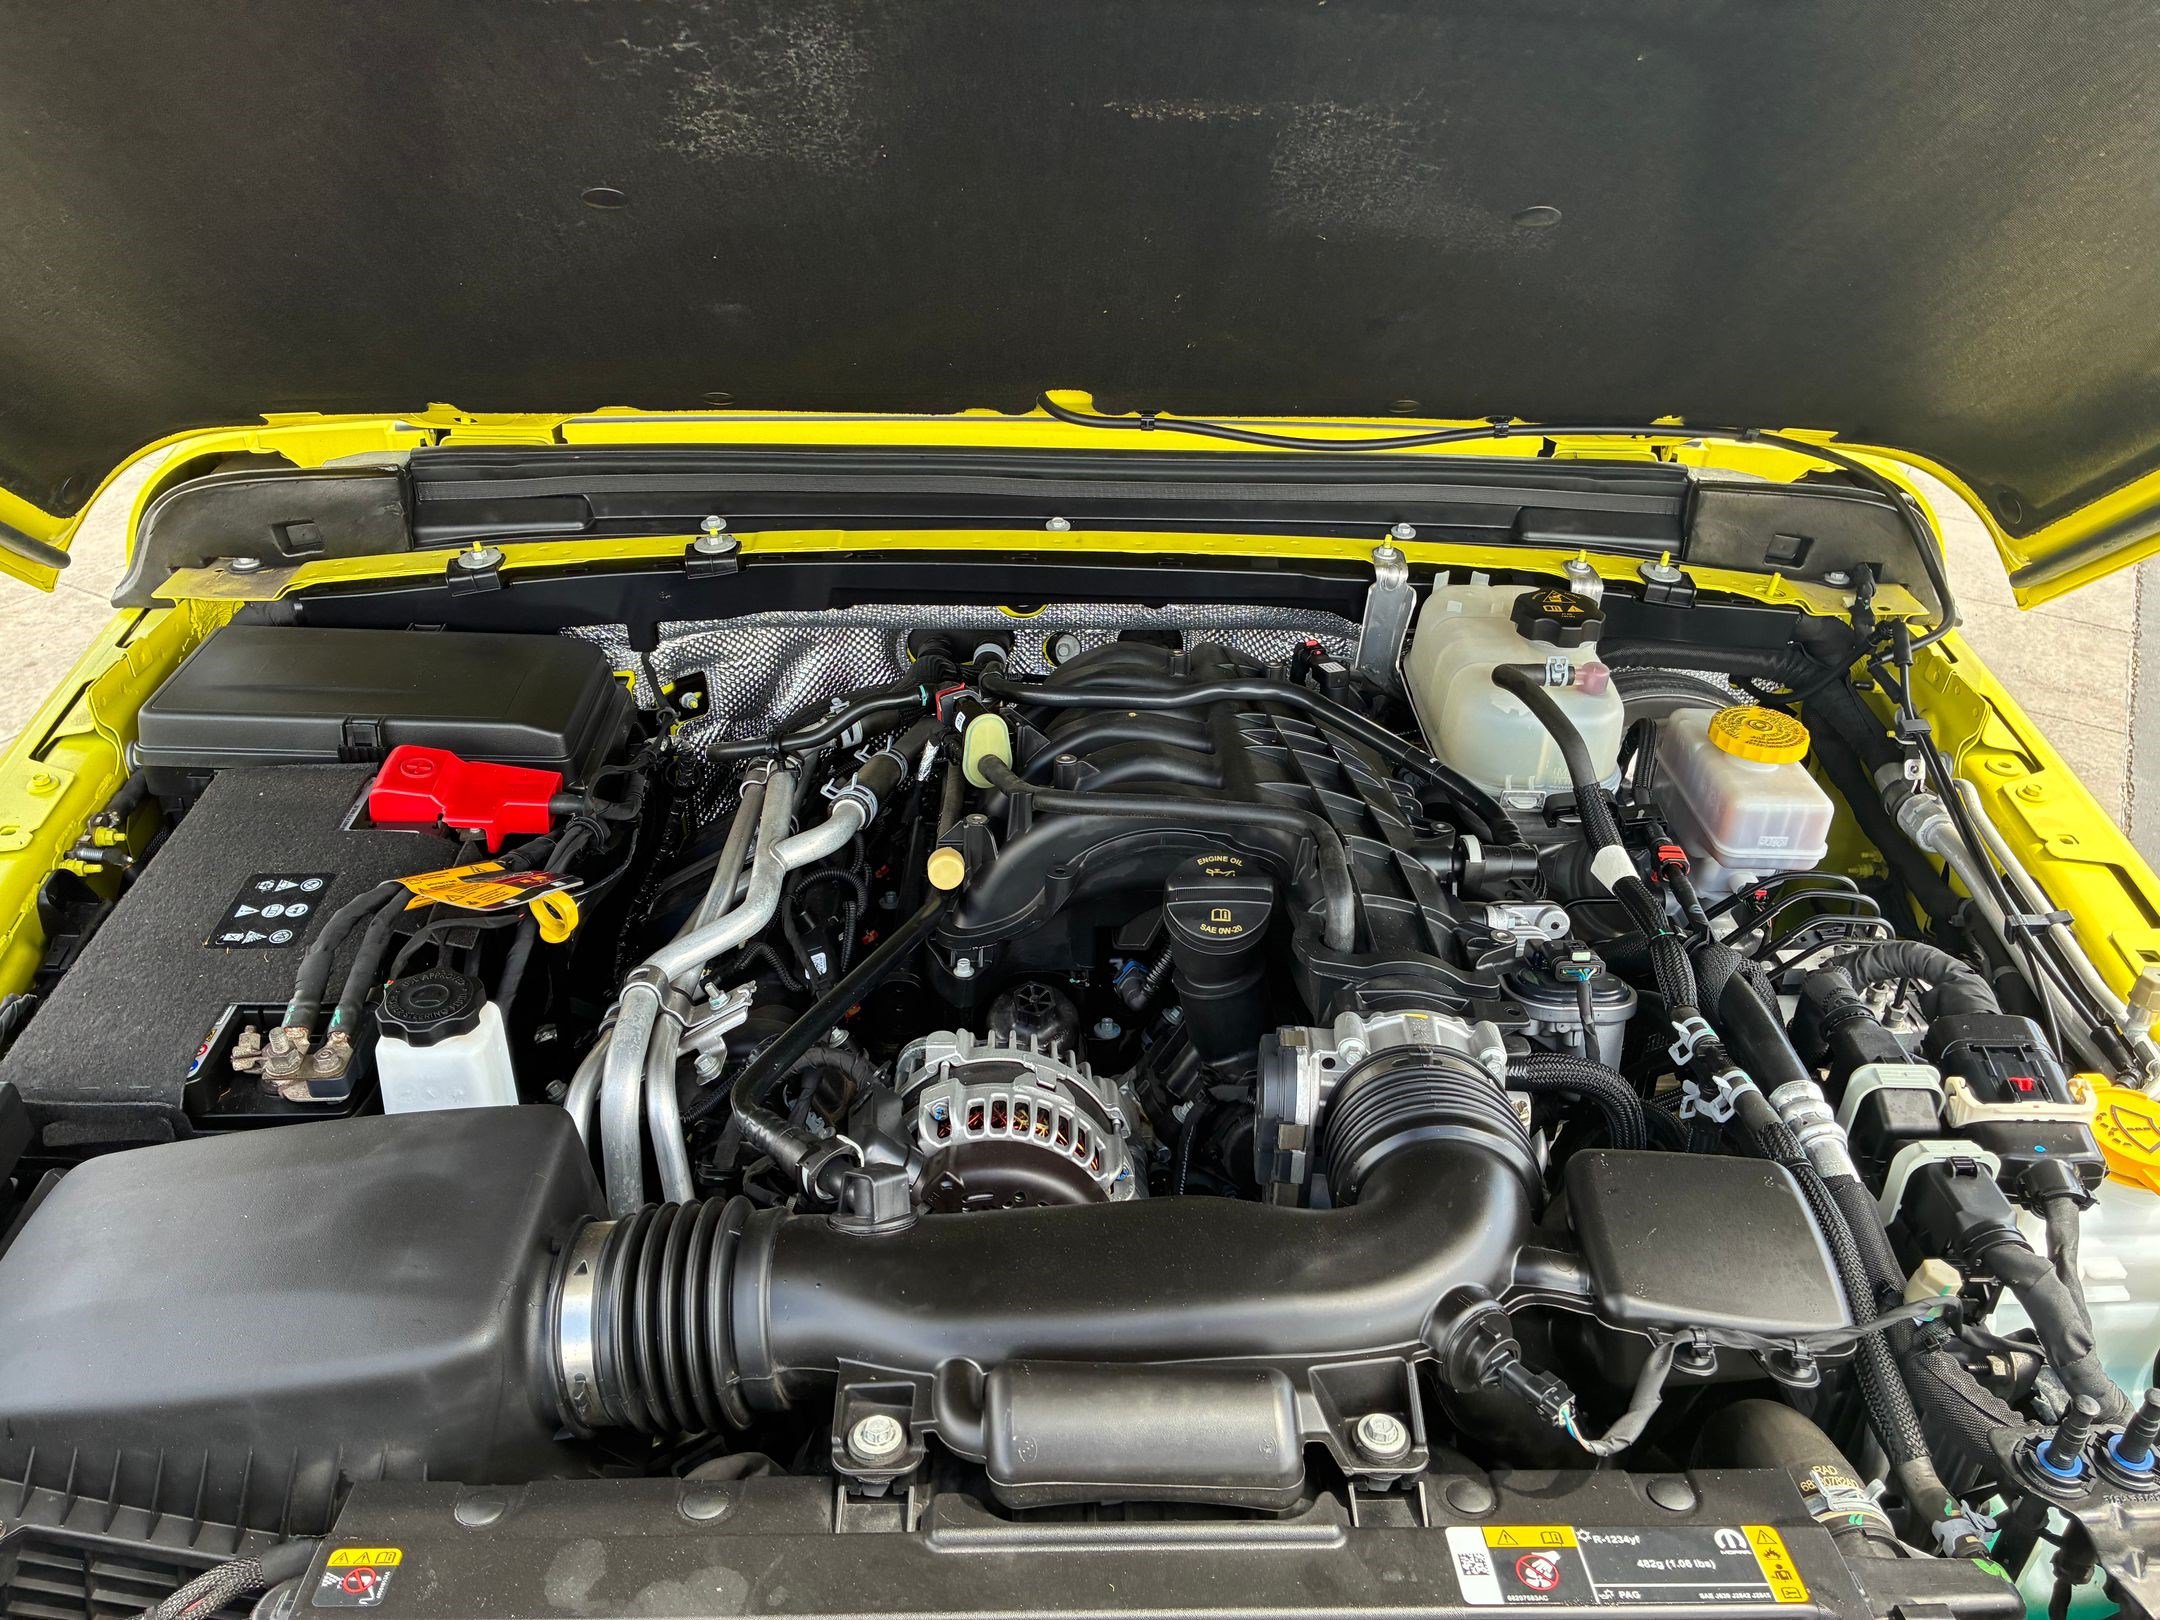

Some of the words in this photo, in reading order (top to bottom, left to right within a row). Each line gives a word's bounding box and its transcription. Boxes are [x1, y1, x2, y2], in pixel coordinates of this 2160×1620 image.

[1197, 855, 1229, 866] ENGINE
[1230, 857, 1243, 867] OIL
[1200, 923, 1217, 934] SAE
[1218, 925, 1243, 935] 0W-20
[402, 976, 420, 987] USE
[422, 971, 465, 986] APPROVED
[403, 1009, 448, 1021] STEERING
[1813, 1465, 1838, 1476] RAD
[1592, 1535, 1640, 1545] R-1234yf
[1637, 1559, 1665, 1570] 482g
[1693, 1559, 1716, 1570] lbs)
[1619, 1590, 1641, 1600] PAG
